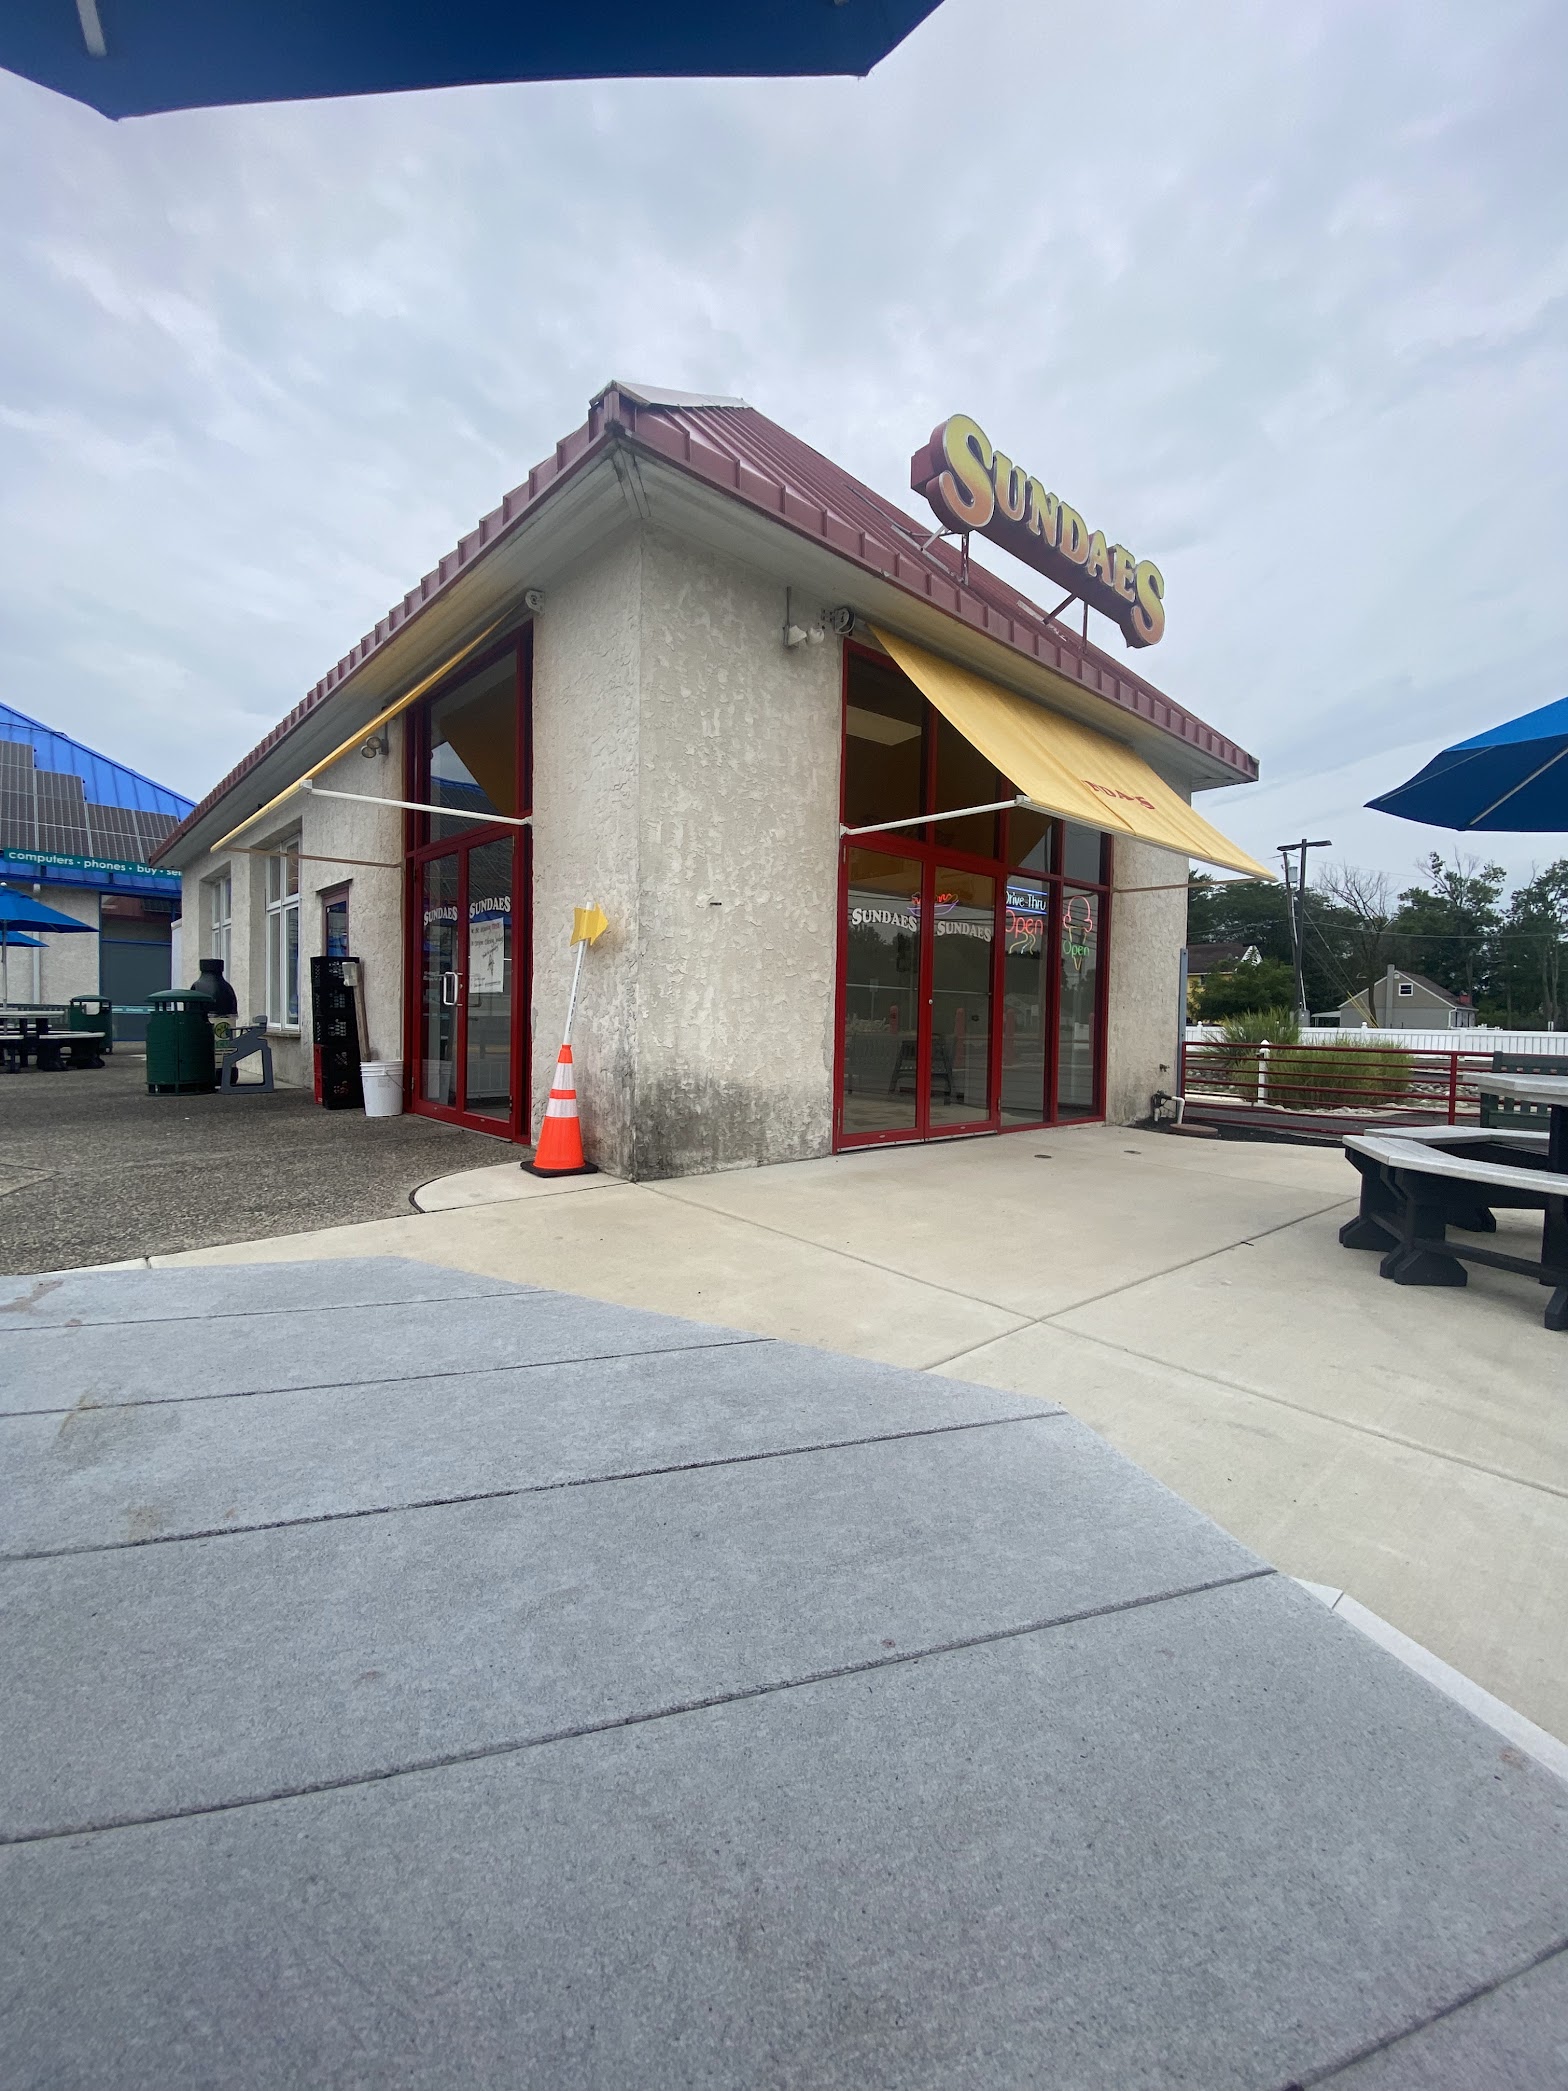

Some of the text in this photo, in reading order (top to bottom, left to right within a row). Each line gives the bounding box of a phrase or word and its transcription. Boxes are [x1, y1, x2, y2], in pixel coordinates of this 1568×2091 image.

[937, 413, 1166, 646] SUNDAES
[8, 851, 74, 866] computers
[84, 860, 126, 871] phones
[137, 864, 157, 876] buy
[423, 905, 458, 926] SUNDAES
[469, 895, 511, 919] SUNDAES
[851, 907, 917, 933] SUNDAES
[936, 920, 992, 943] SUNDAES
[1005, 909, 1044, 939] Open
[1062, 939, 1090, 958] Open
